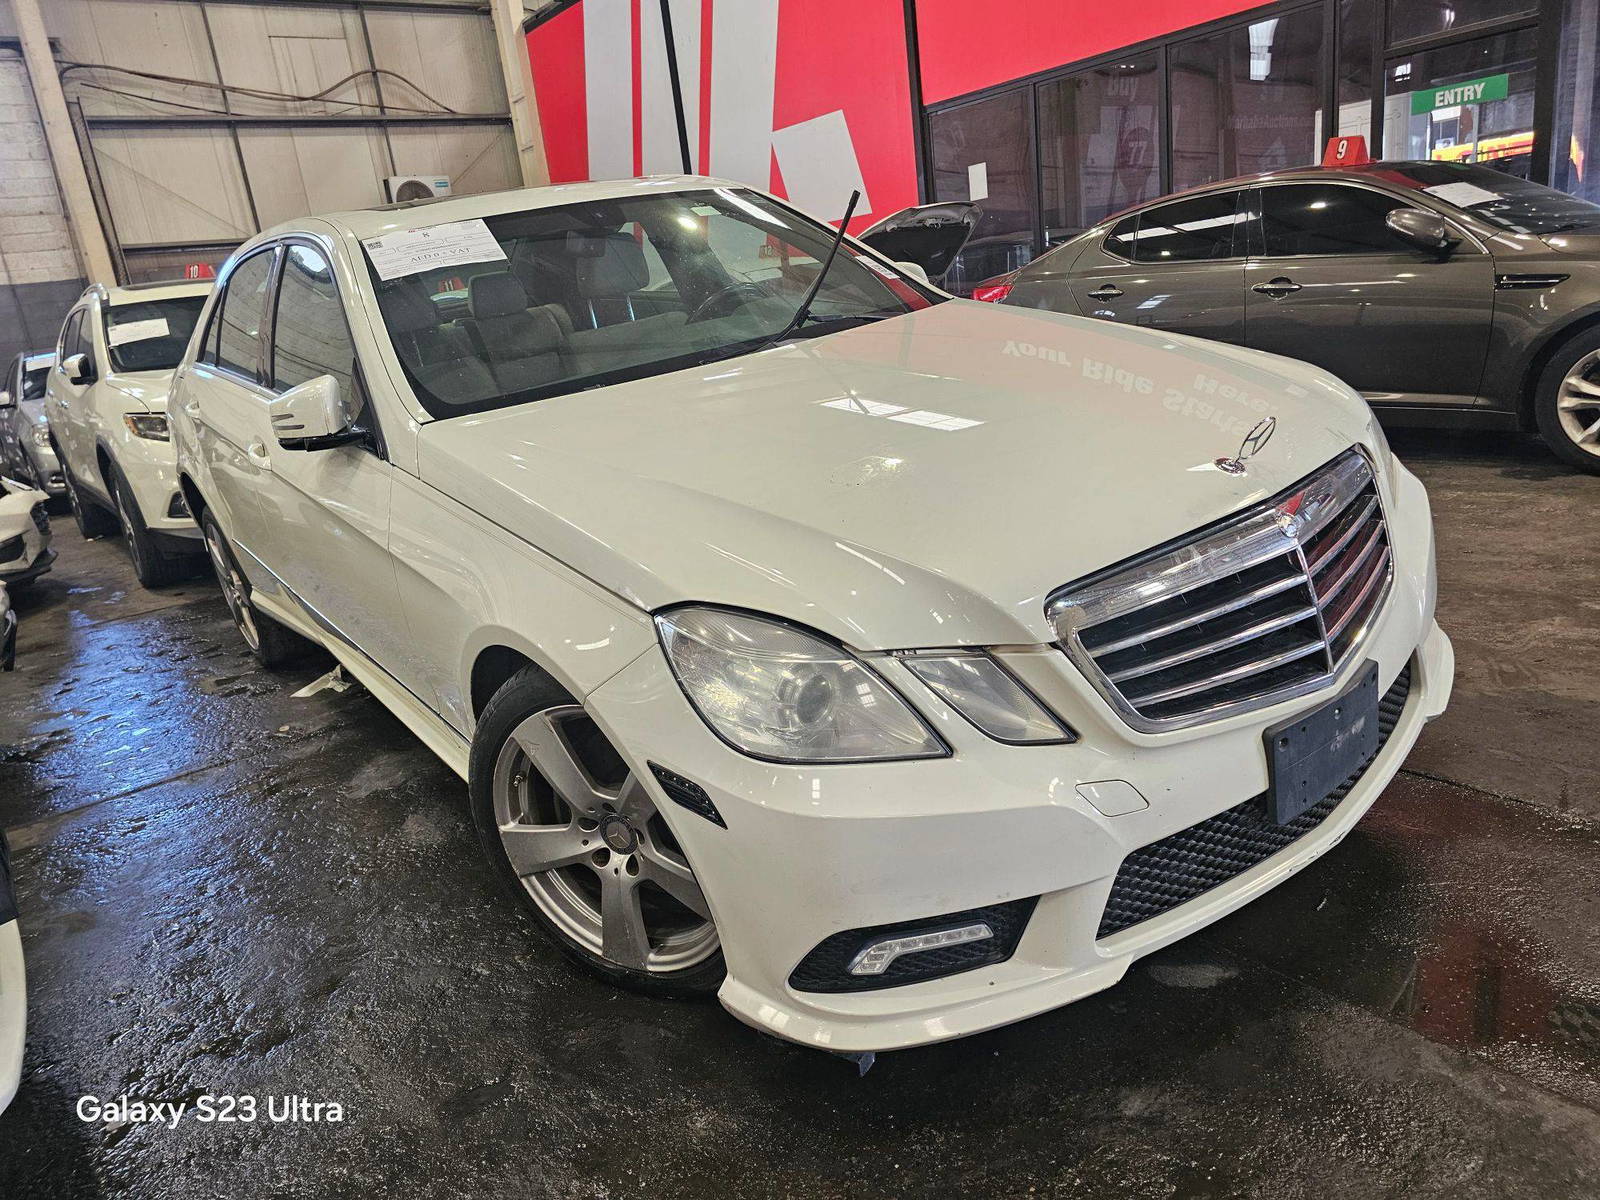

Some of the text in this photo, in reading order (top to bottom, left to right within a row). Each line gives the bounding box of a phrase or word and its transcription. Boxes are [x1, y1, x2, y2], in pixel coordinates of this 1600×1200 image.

[1435, 82, 1486, 107] ENTRY
[1336, 139, 1348, 160] 9
[190, 264, 199, 279] 10
